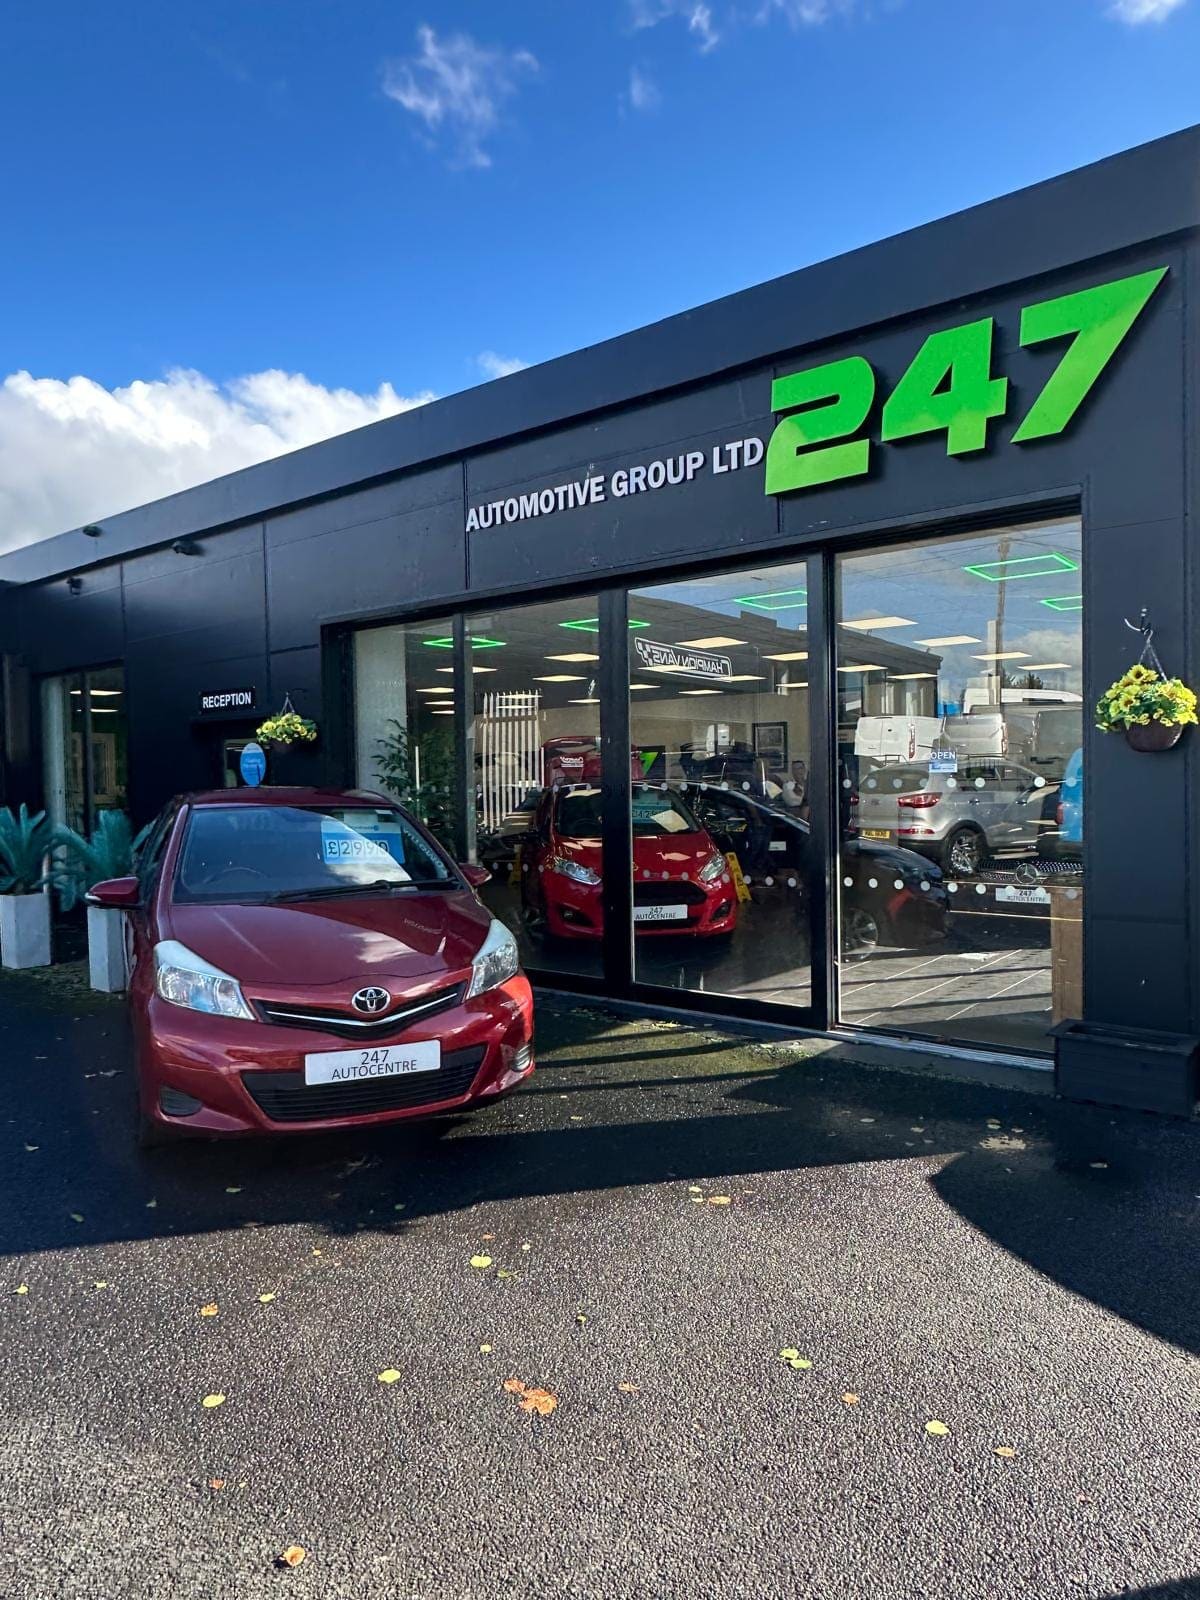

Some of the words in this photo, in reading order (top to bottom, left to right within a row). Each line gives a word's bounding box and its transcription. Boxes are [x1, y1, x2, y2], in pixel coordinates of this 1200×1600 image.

[765, 265, 1170, 496] 247
[465, 475, 605, 532] AUTOMOTIVE
[611, 451, 705, 497] GROUP
[712, 437, 765, 475] LTD
[202, 691, 252, 709] RECEPTION
[930, 751, 957, 760] OPEN
[649, 906, 663, 915] 247
[361, 1049, 390, 1065] 247
[331, 1059, 418, 1081] AUTOCENTRE
